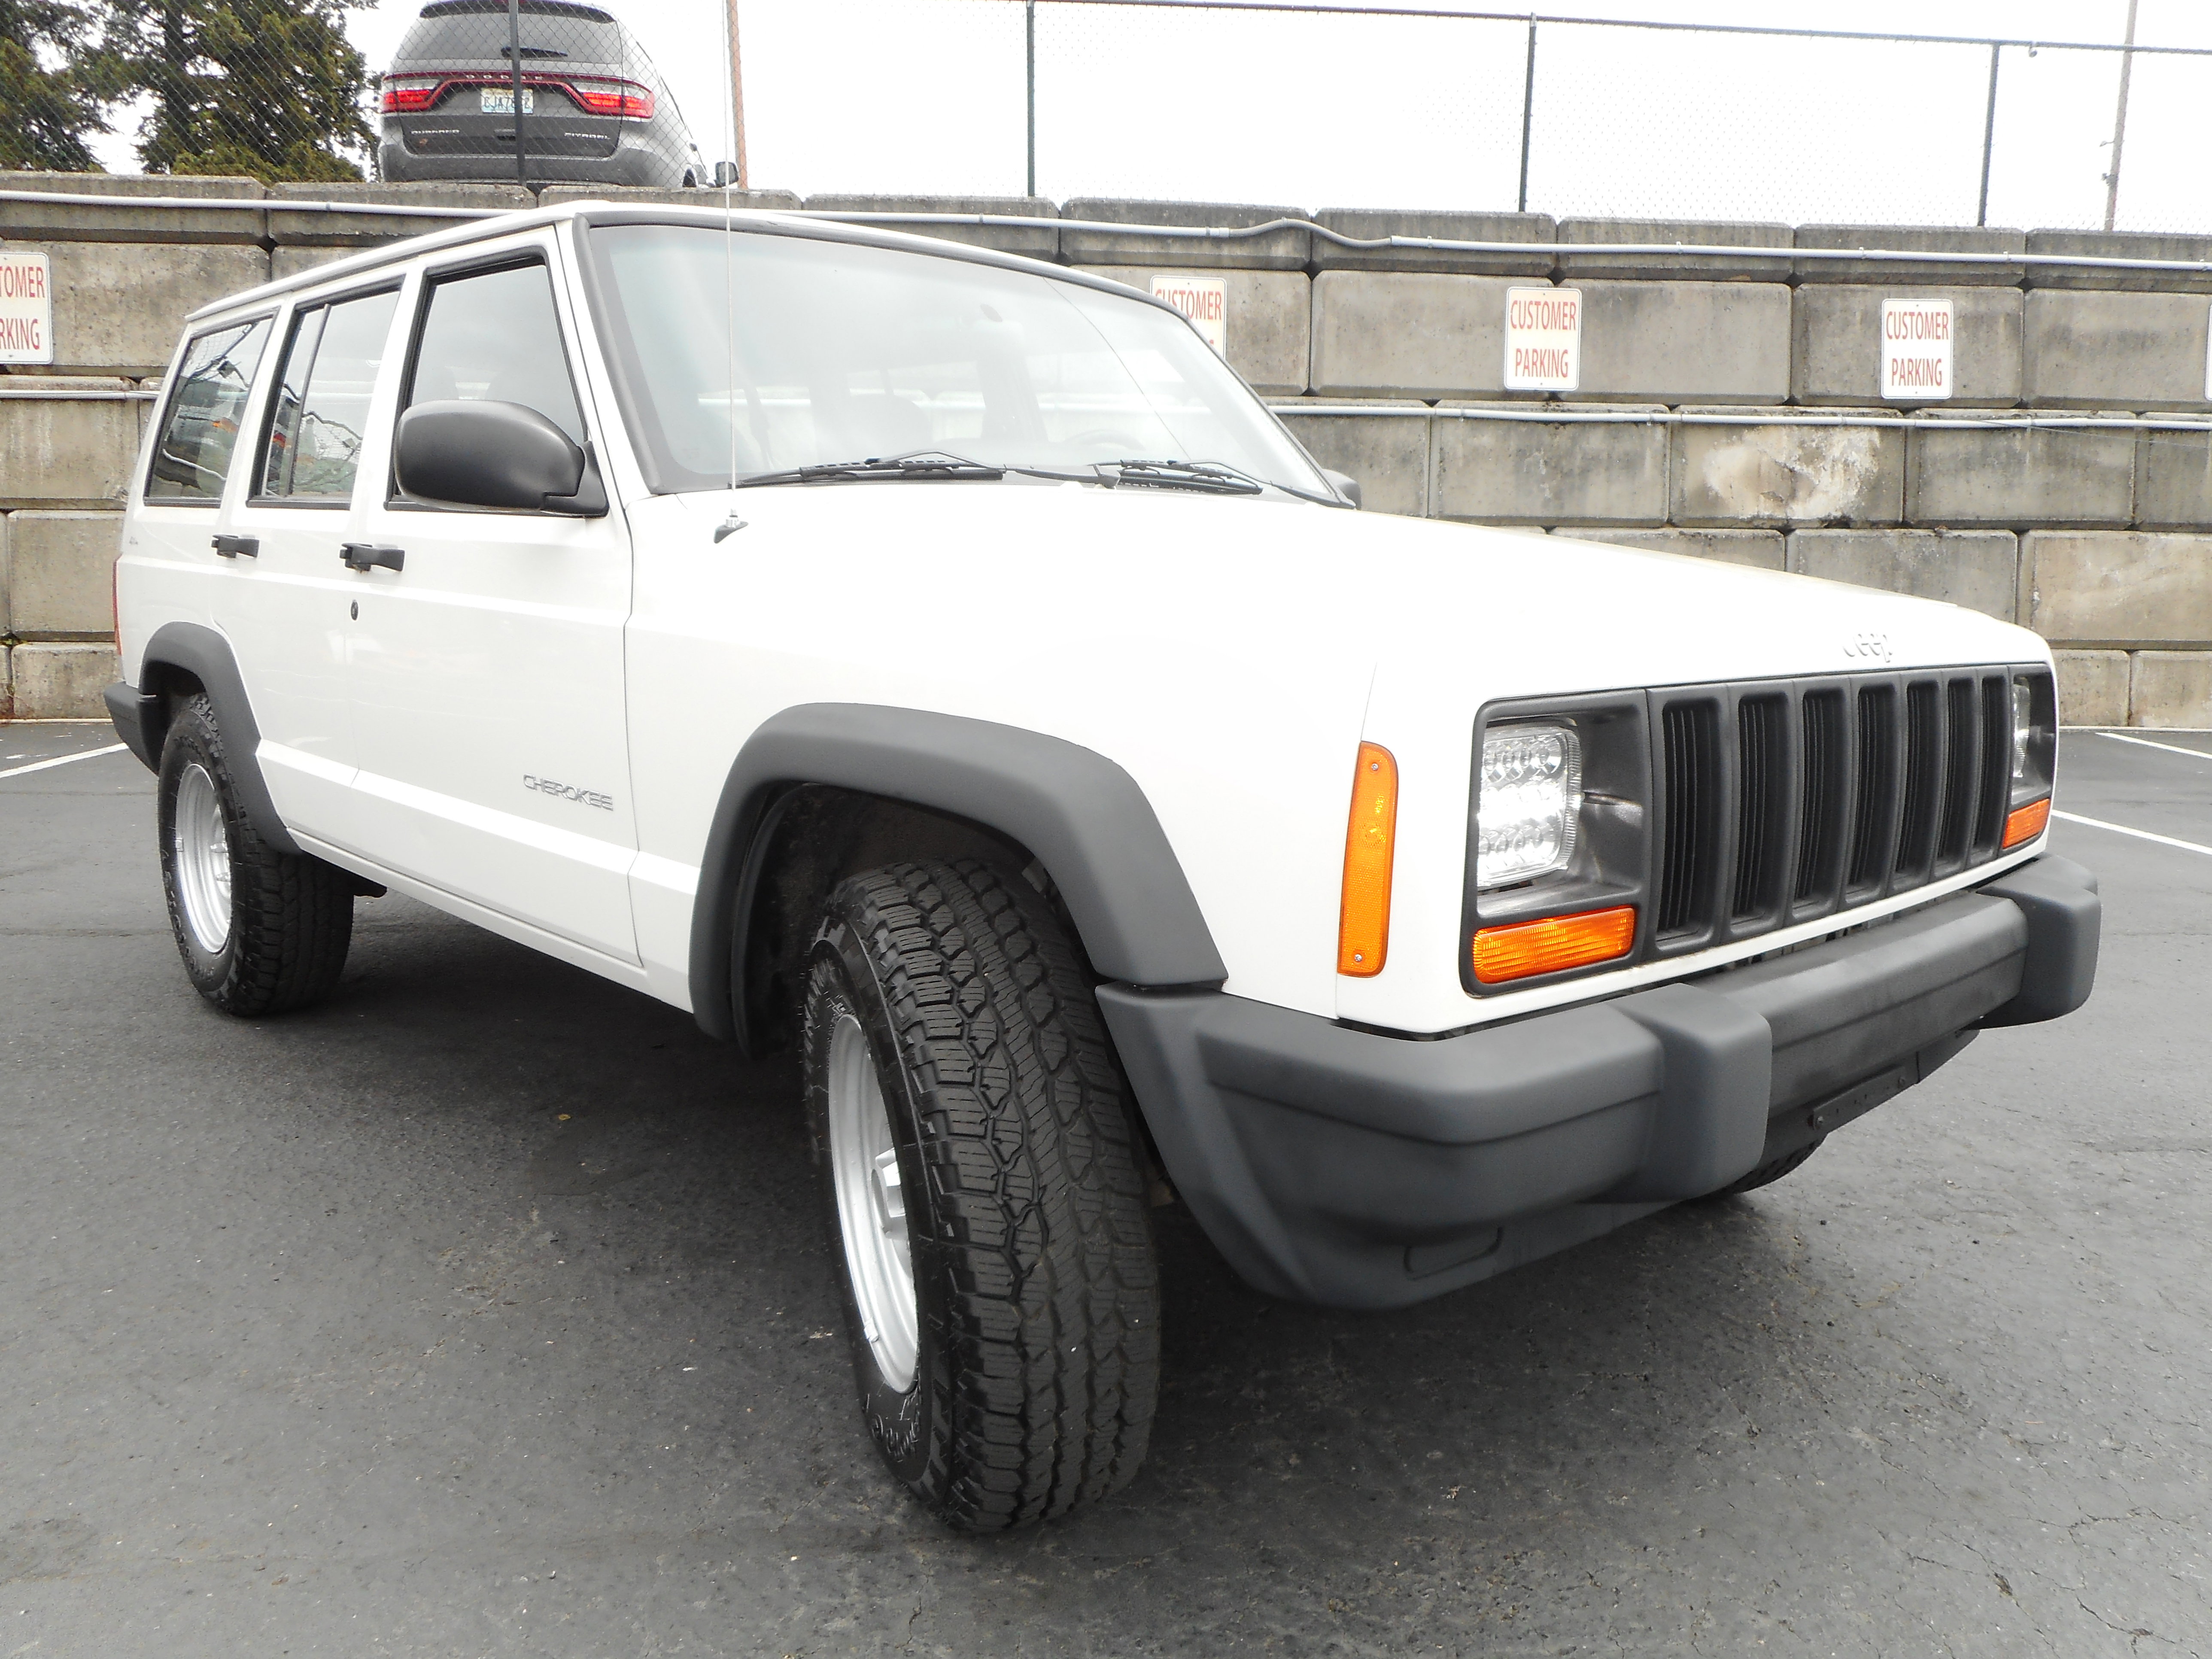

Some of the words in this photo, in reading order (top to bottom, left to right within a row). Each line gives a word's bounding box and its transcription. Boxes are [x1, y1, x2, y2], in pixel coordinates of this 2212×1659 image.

[1510, 300, 1576, 330] CUSTOMER
[1887, 311, 1949, 340] CUSTOMER
[1515, 348, 1568, 378] PARKING
[1892, 358, 1942, 386] PARKING
[1842, 633, 1893, 663] Jeep
[523, 773, 614, 811] CHEROKEE
